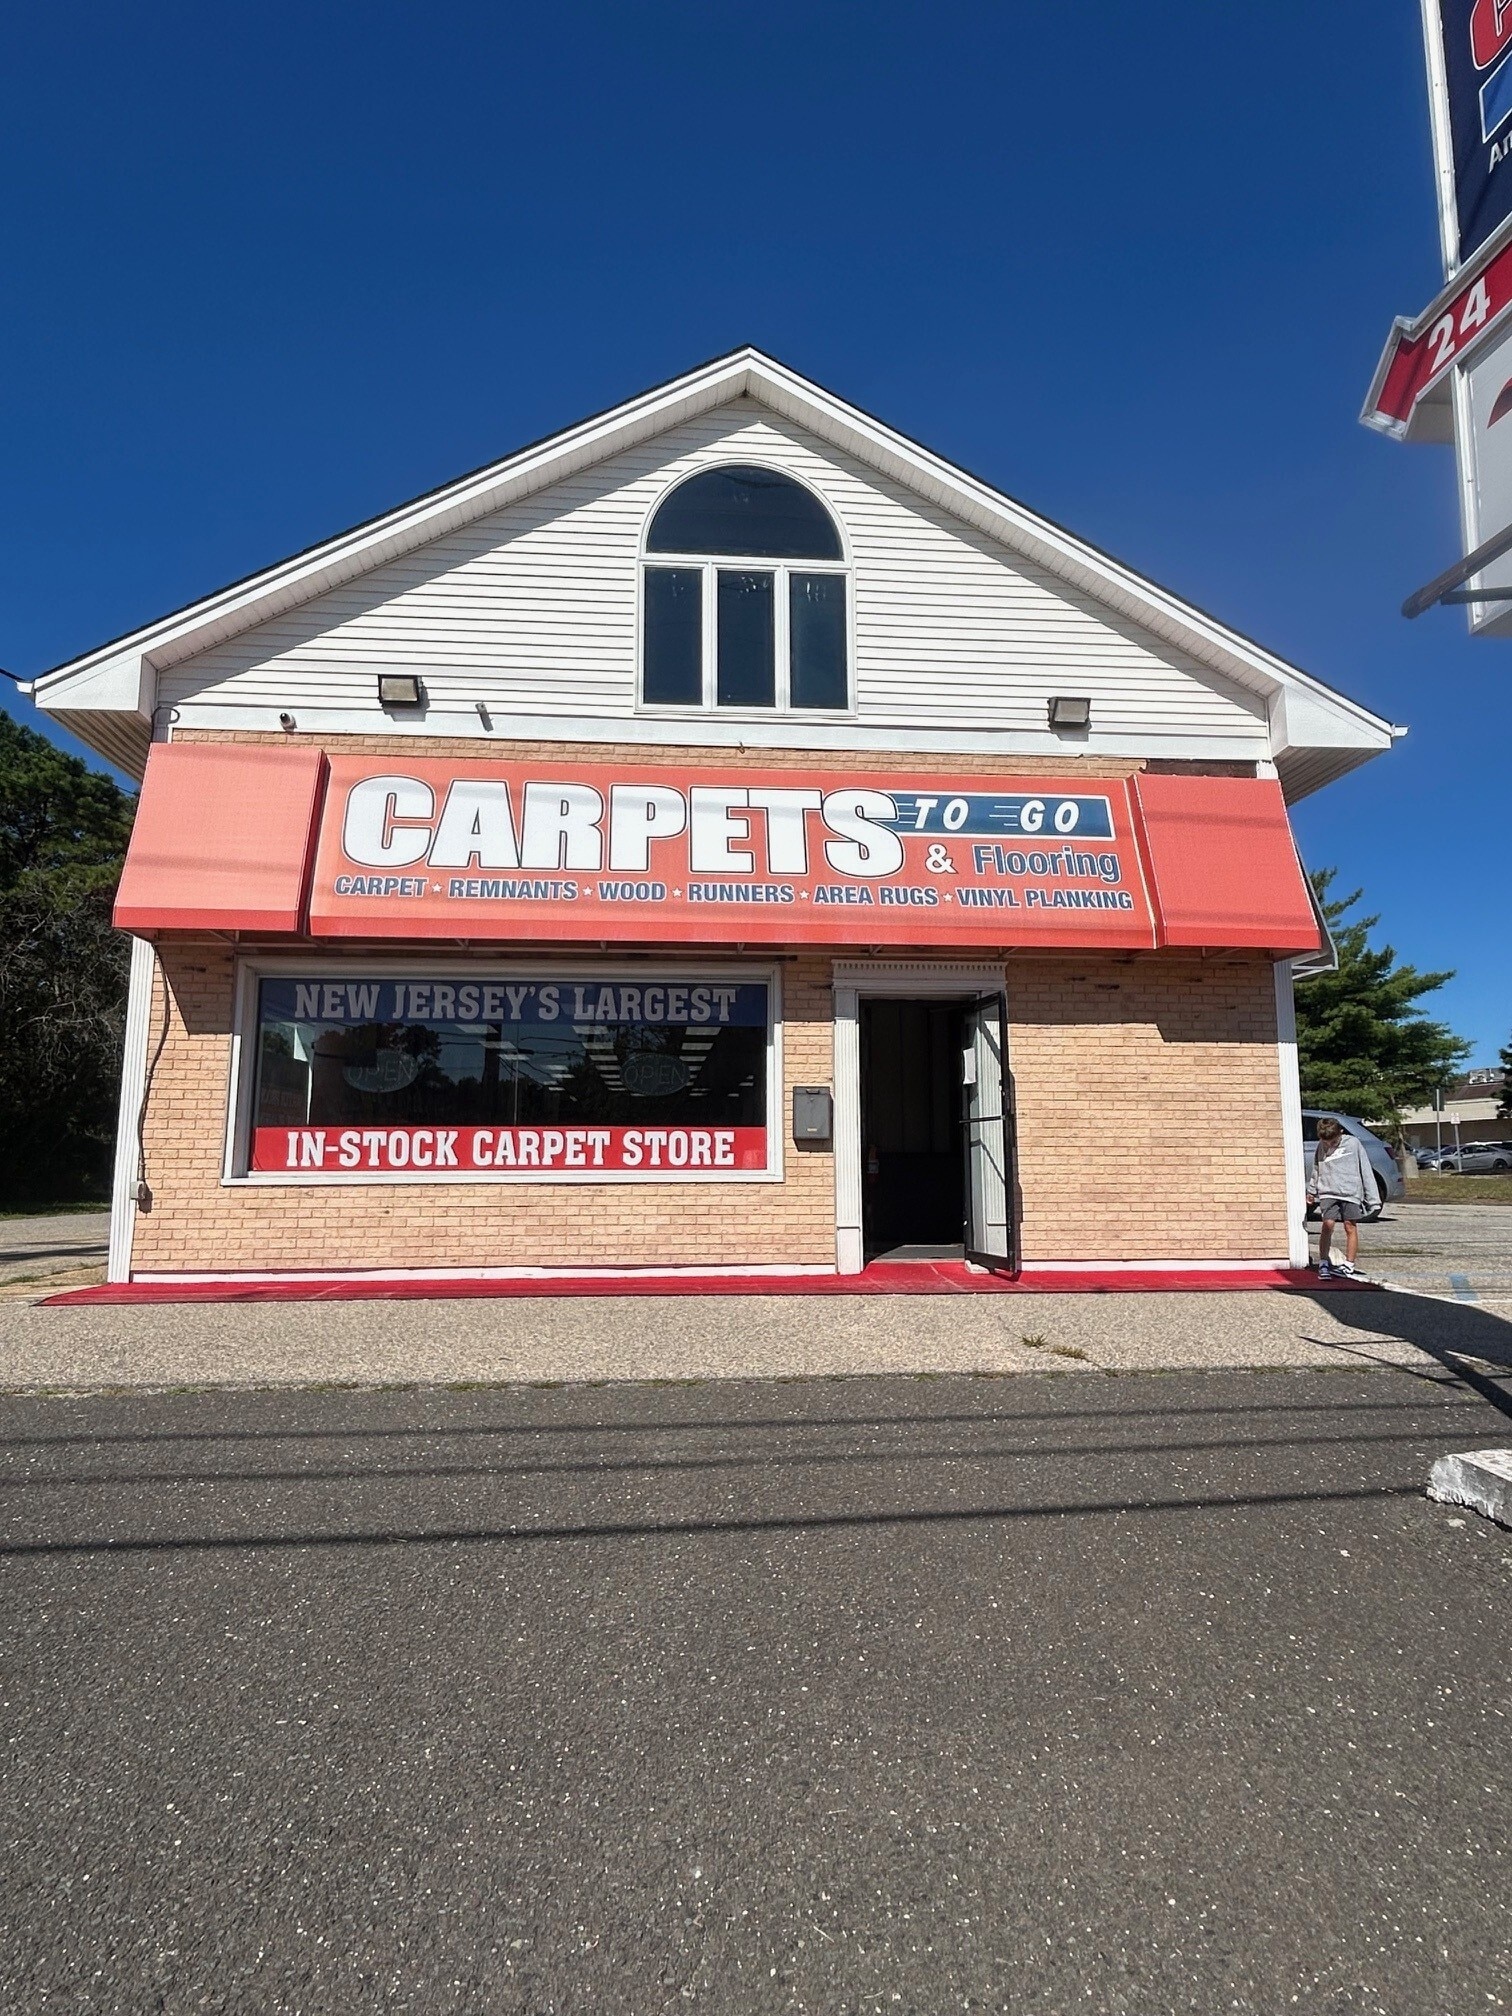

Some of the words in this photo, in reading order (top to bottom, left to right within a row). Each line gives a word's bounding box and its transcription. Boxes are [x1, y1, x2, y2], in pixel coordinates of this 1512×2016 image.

[1428, 276, 1491, 374] 24
[343, 774, 905, 878] CARPETS
[914, 798, 969, 831] TO
[1020, 800, 1080, 832] GO
[925, 843, 958, 874] &
[972, 845, 1122, 883] Flooring
[335, 875, 428, 898] CARPET
[448, 878, 578, 900] REMNANTS
[599, 882, 666, 902] WOOD
[687, 883, 794, 904] RUNNERS
[814, 884, 873, 905] AREA
[880, 886, 938, 907] RUGS
[957, 888, 1019, 908] VINYL
[1026, 889, 1133, 910] PLANKING
[294, 984, 380, 1019] NEW
[392, 984, 560, 1021] JERSEY'S
[574, 986, 736, 1022] LARGEST
[286, 1130, 459, 1167] IN-STOCK
[472, 1130, 610, 1167] CARPET
[622, 1130, 735, 1167] STORE
